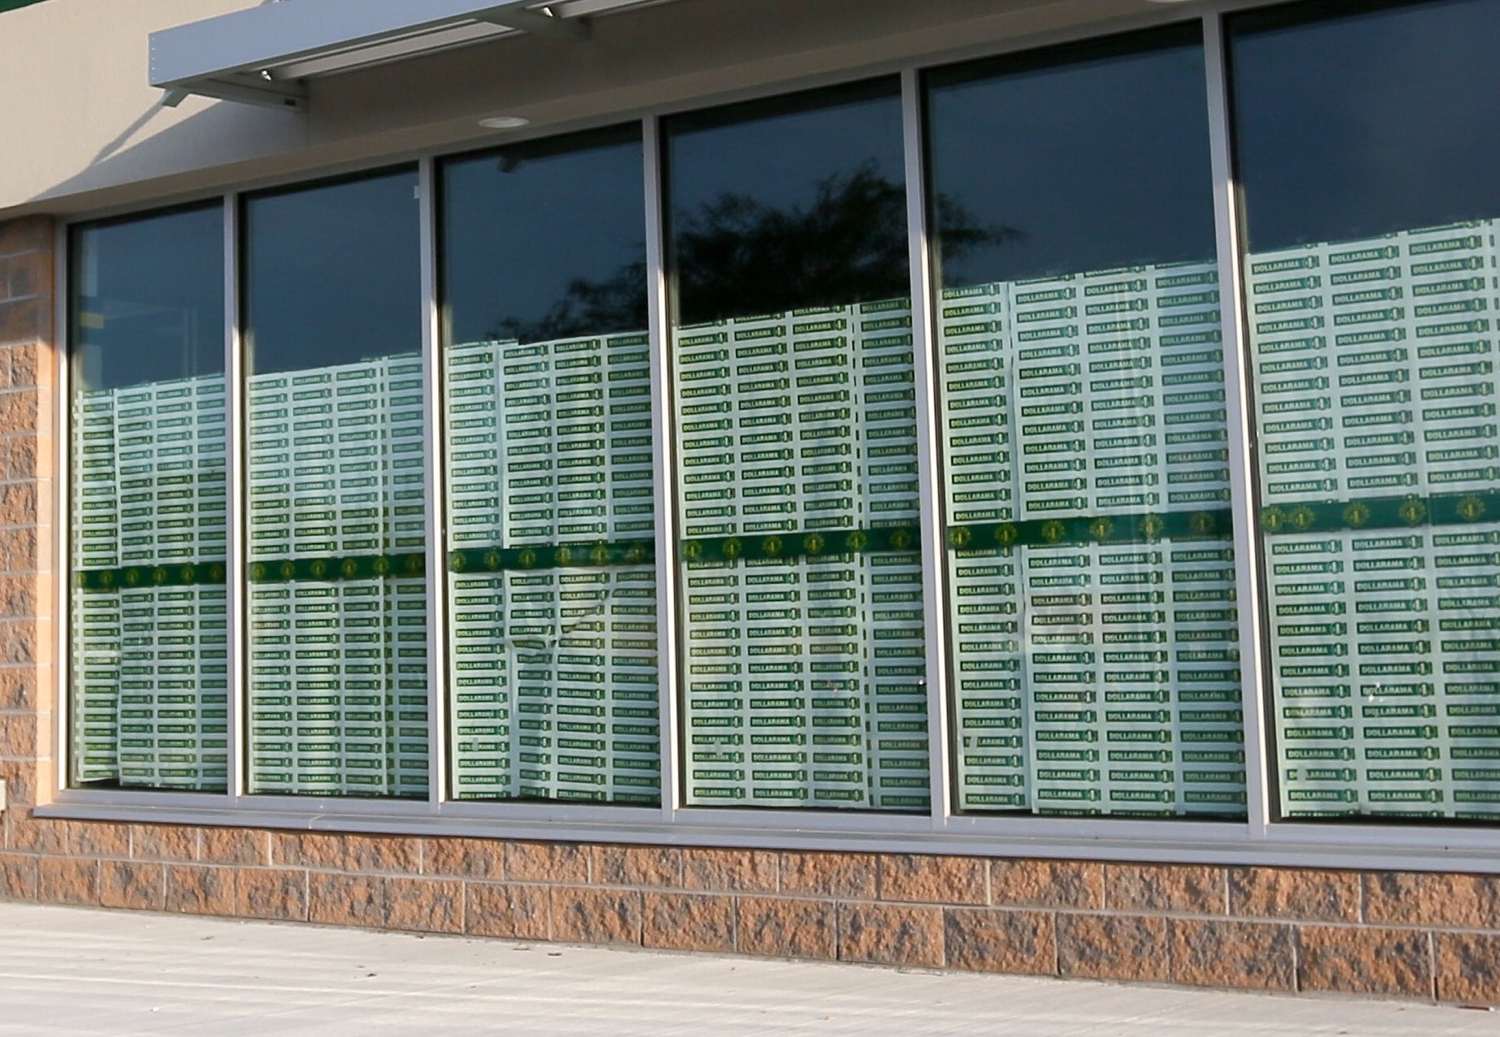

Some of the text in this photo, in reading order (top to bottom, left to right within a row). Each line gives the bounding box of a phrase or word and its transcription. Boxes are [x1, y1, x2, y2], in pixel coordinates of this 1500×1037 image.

[1330, 250, 1378, 264] DOLLARAMA
[1253, 259, 1300, 273] DOLLARAMA
[1332, 270, 1380, 284] DOLLARAMA
[1255, 279, 1302, 293] DOLLARAMA
[1017, 291, 1058, 303] DOLLARAMA
[1334, 290, 1382, 304] DOLLARAMA
[1256, 299, 1303, 313] DOLLARAMA
[1018, 309, 1060, 322] DOLLARAMA
[1335, 311, 1383, 325] DOLLARAMA
[1258, 319, 1305, 333] DOLLARAMA
[1019, 328, 1061, 341] DOLLARAMA
[1337, 331, 1385, 345] DOLLARAMA
[1259, 339, 1306, 353] DOLLARAMA
[1020, 347, 1062, 359] DOLLARAMA
[1339, 352, 1387, 365] DOLLARAMA
[1021, 366, 1063, 378] DOLLARAMA
[1261, 360, 1308, 373] DOLLARAMA
[1341, 372, 1389, 386] DOLLARAMA
[1022, 385, 1064, 397] DOLLARAMA
[1262, 380, 1309, 393] DOLLARAMA
[1342, 393, 1391, 406] DOLLARAMA
[1023, 404, 1065, 416] DOLLARAMA
[1264, 400, 1311, 413] DOLLARAMA
[1344, 413, 1393, 426] DOLLARAMA
[1024, 423, 1066, 435] DOLLARAMA
[1265, 420, 1312, 433] DOLLARAMA
[1345, 434, 1394, 447] DOLLARAMA
[1025, 442, 1067, 453] DOLLARAMA
[1267, 440, 1314, 453] DOLLARAMA
[1026, 461, 1068, 472] DOLLARAMA
[1347, 455, 1396, 467] DOLLARAMA
[1268, 461, 1315, 473] DOLLARAMA
[1027, 480, 1069, 491] DOLLARAMA
[1269, 481, 1317, 493] DOLLARAMA
[1349, 476, 1398, 488] DOLLARAMA
[1027, 499, 1070, 510] DOLLARAMA
[1274, 543, 1321, 554] DOLLARAMA
[1353, 538, 1403, 550] DOLLARAMA
[1030, 557, 1072, 567] DOLLARAMA
[1355, 559, 1404, 570] DOLLARAMA
[1275, 563, 1322, 574] DOLLARAMA
[1031, 576, 1073, 586] DOLLARAMA
[1356, 580, 1406, 591] DOLLARAMA
[1276, 584, 1324, 594] DOLLARAMA
[1032, 596, 1074, 605] DOLLARAMA
[1278, 604, 1325, 615] DOLLARAMA
[1357, 601, 1407, 612] DOLLARAMA
[1033, 615, 1075, 624] DOLLARAMA
[1279, 625, 1327, 635] DOLLARAMA
[1359, 622, 1409, 632] DOLLARAMA
[1033, 634, 1076, 643] DOLLARAMA
[1280, 645, 1328, 656] DOLLARAMA
[1360, 643, 1410, 653] DOLLARAMA
[1034, 653, 1077, 663] DOLLARAMA
[1282, 666, 1329, 676] DOLLARAMA
[1361, 664, 1412, 674] DOLLARAMA
[1035, 673, 1077, 682] DOLLARAMA
[1036, 693, 1078, 701] DOLLARAMA
[1283, 687, 1331, 696] DOLLARAMA
[1036, 712, 1079, 721] DOLLARAMA
[1364, 706, 1415, 716] DOLLARAMA
[1037, 731, 1080, 740] DOLLARAMA
[1286, 728, 1334, 738] DOLLARAMA
[1365, 728, 1416, 737] DOLLARAMA
[1038, 751, 1081, 760] DOLLARAMA
[1287, 749, 1335, 758] DOLLARAMA
[1367, 749, 1417, 758] DOLLARAMA
[1039, 770, 1081, 779] DOLLARAMA
[1368, 770, 1419, 779] DOLLARAMA
[1039, 790, 1082, 799] DOLLARAMA
[1290, 791, 1338, 800] DOLLARAMA
[1369, 791, 1420, 800] DOLLARAMA
